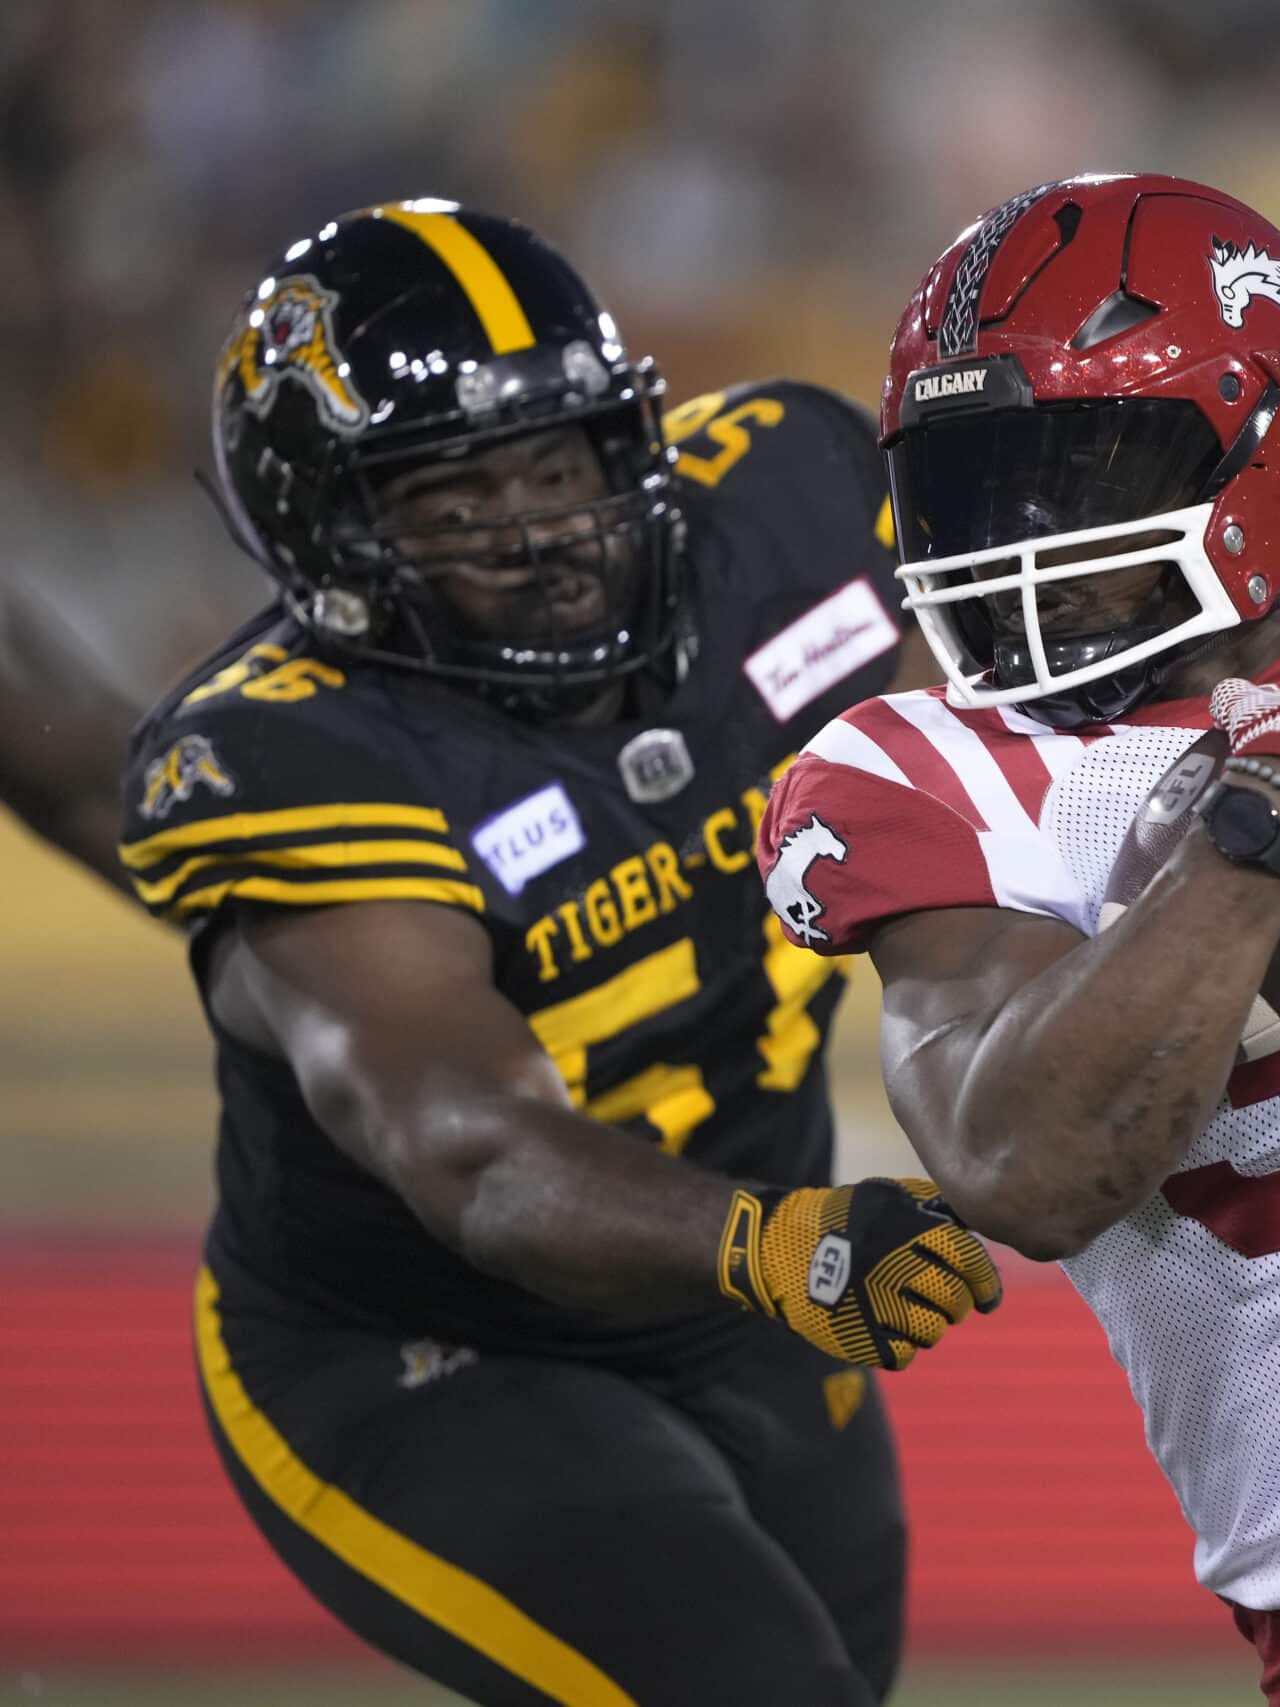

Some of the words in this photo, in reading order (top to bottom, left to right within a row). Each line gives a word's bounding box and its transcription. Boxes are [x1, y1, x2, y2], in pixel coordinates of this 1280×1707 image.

[915, 369, 987, 401] CALGARY
[1160, 764, 1203, 812] CFL
[816, 1246, 841, 1289] CFL
